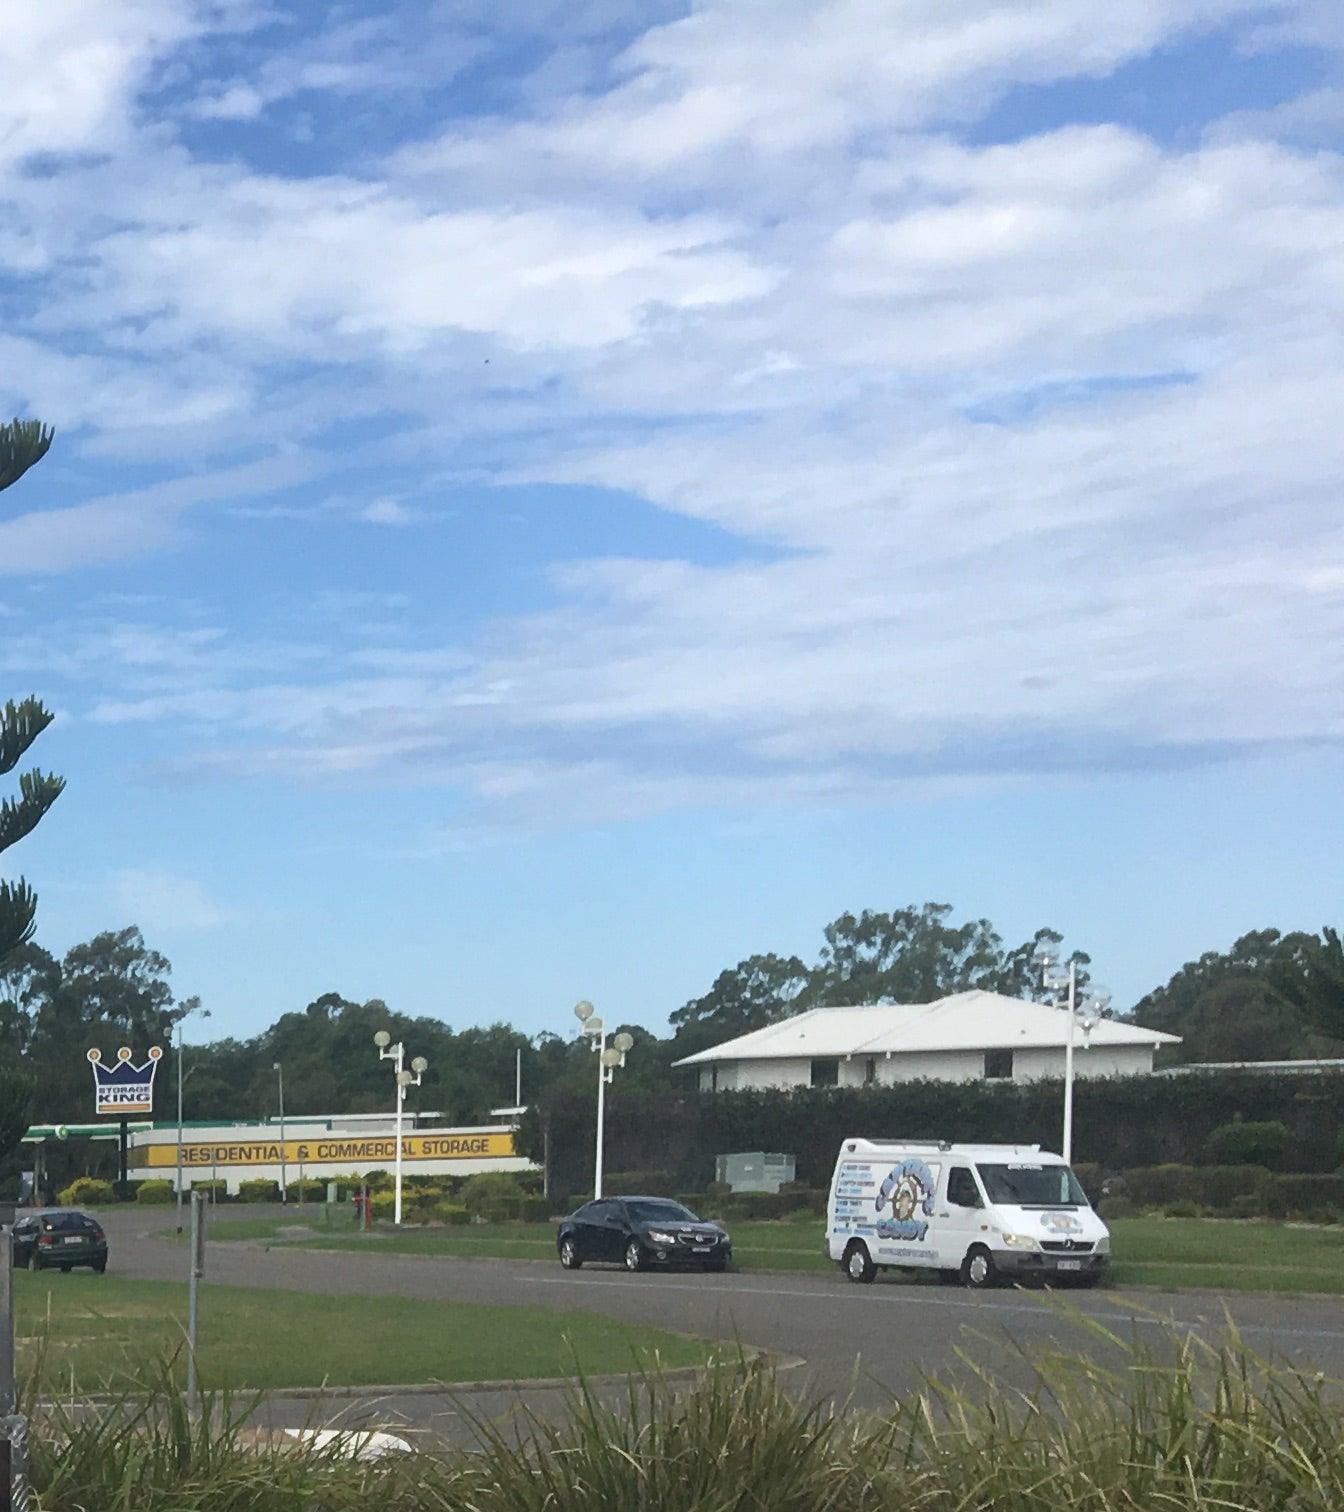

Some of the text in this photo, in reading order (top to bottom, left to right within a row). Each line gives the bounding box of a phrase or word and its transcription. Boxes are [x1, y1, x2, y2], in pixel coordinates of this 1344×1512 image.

[99, 1086, 150, 1094] STORAGE
[99, 1094, 151, 1103] KING
[297, 1145, 310, 1159] &
[422, 1138, 490, 1155] STORAGE
